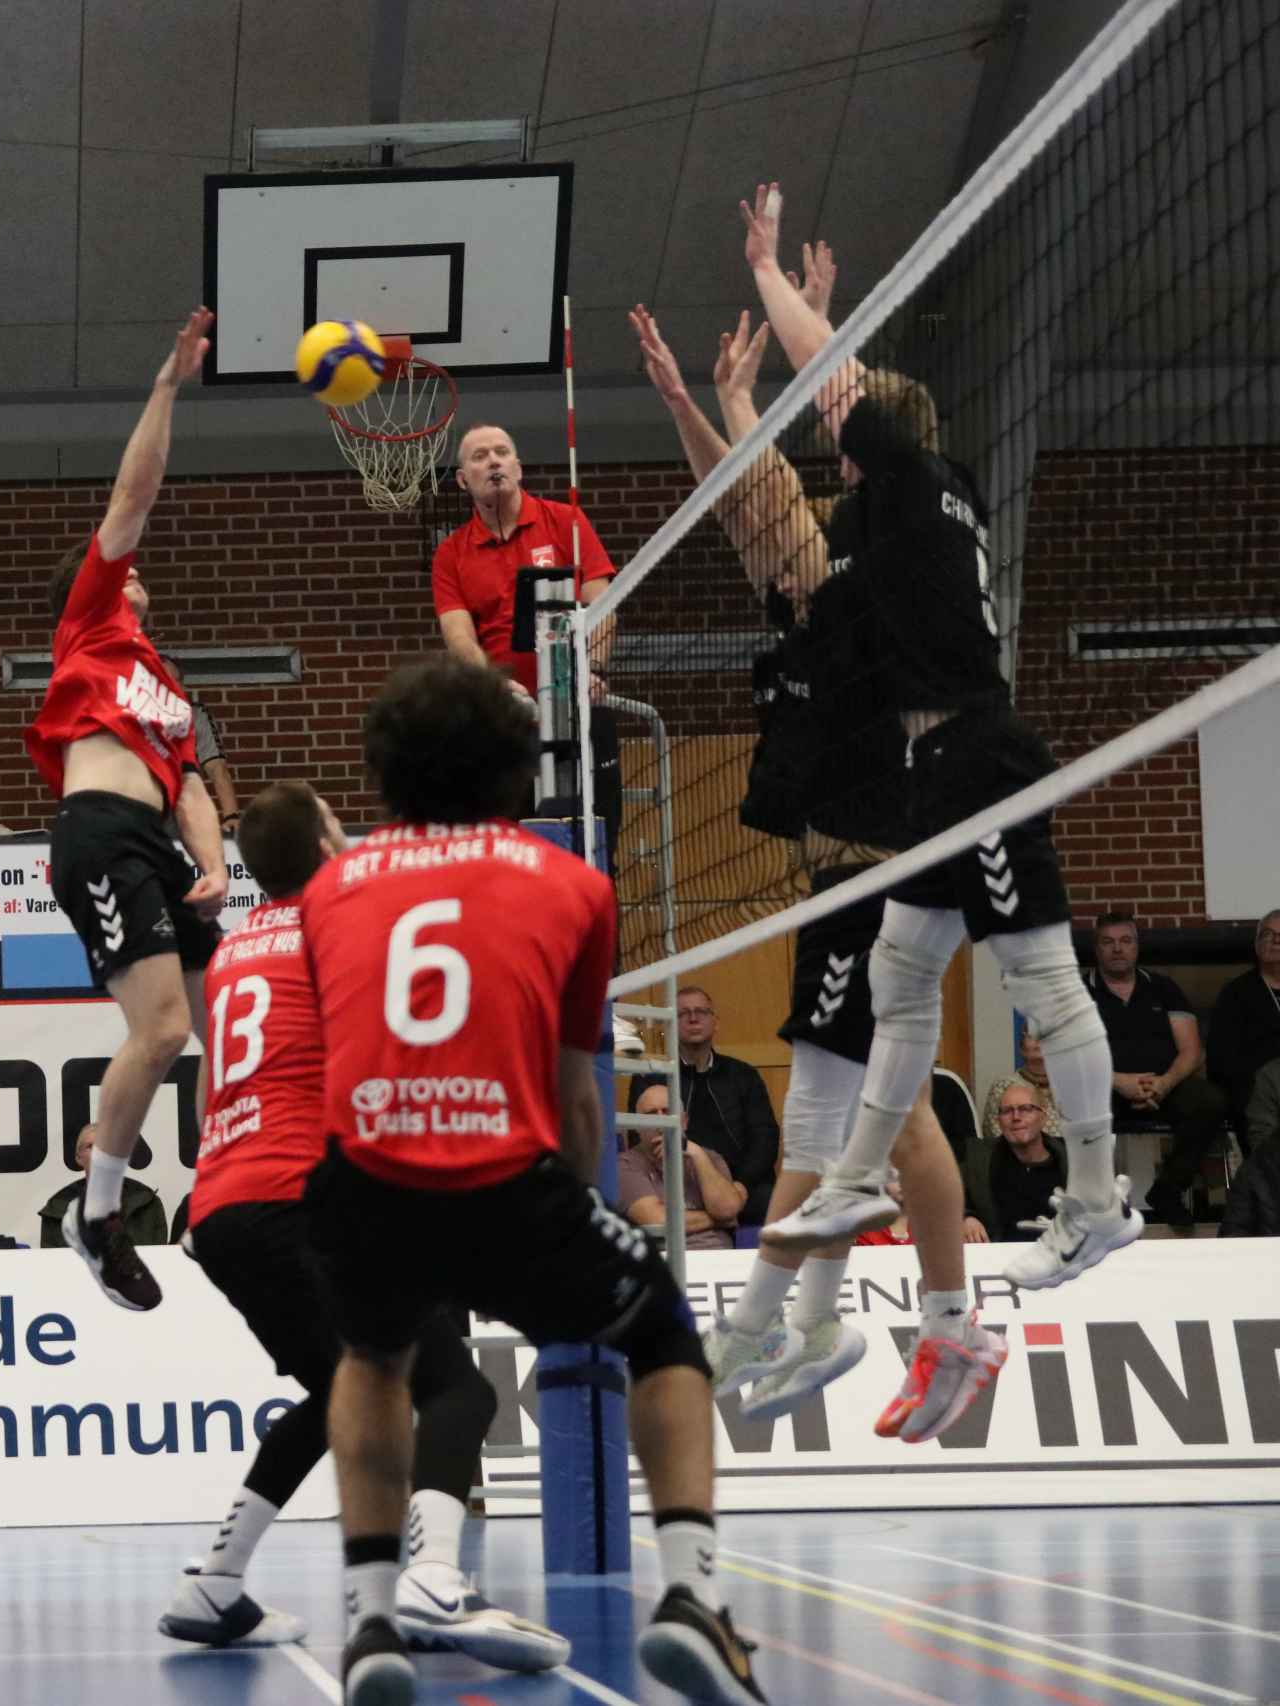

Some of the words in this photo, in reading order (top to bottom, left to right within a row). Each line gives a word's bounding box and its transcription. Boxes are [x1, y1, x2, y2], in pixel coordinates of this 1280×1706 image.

[4, 898, 22, 914] af:
[26, 898, 58, 913] Vare
[384, 898, 470, 1046] 6
[212, 975, 271, 1092] 13
[395, 1076, 508, 1105] TOYOTA
[431, 1104, 509, 1136] Lund
